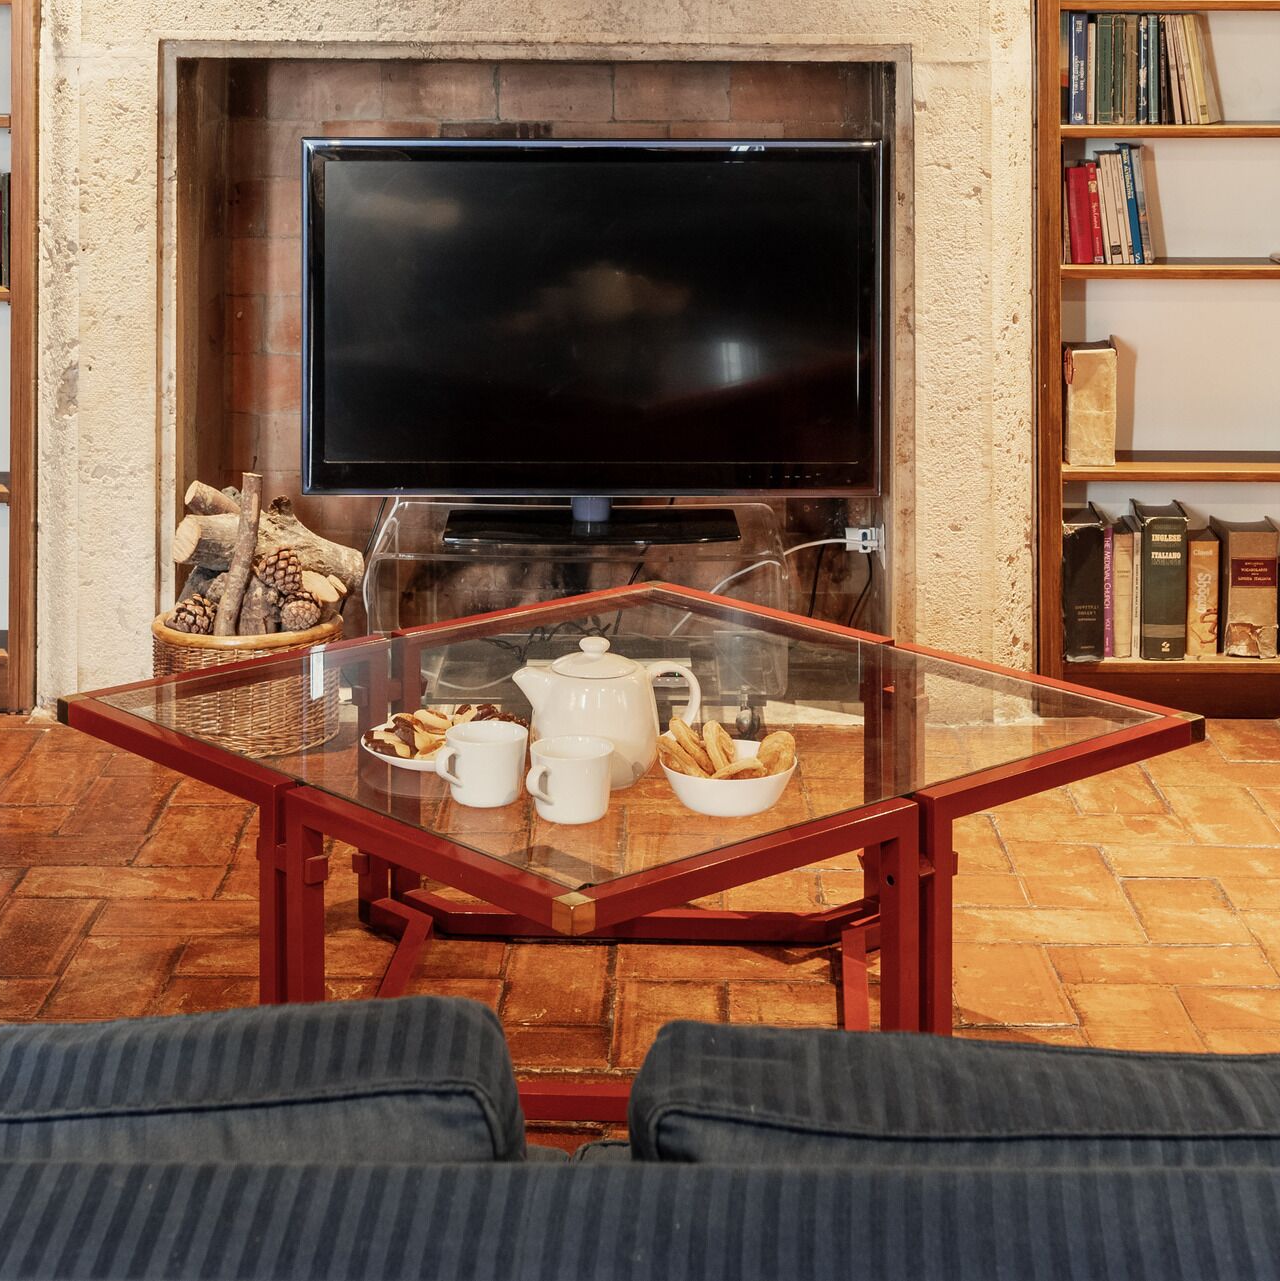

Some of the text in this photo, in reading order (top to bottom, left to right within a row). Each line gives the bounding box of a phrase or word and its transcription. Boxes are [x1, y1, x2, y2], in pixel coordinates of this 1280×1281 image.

[1123, 165, 1132, 199] ALTERNATIVA
[1151, 534, 1182, 542] INGLESE
[1151, 551, 1181, 559] ITALIANO
